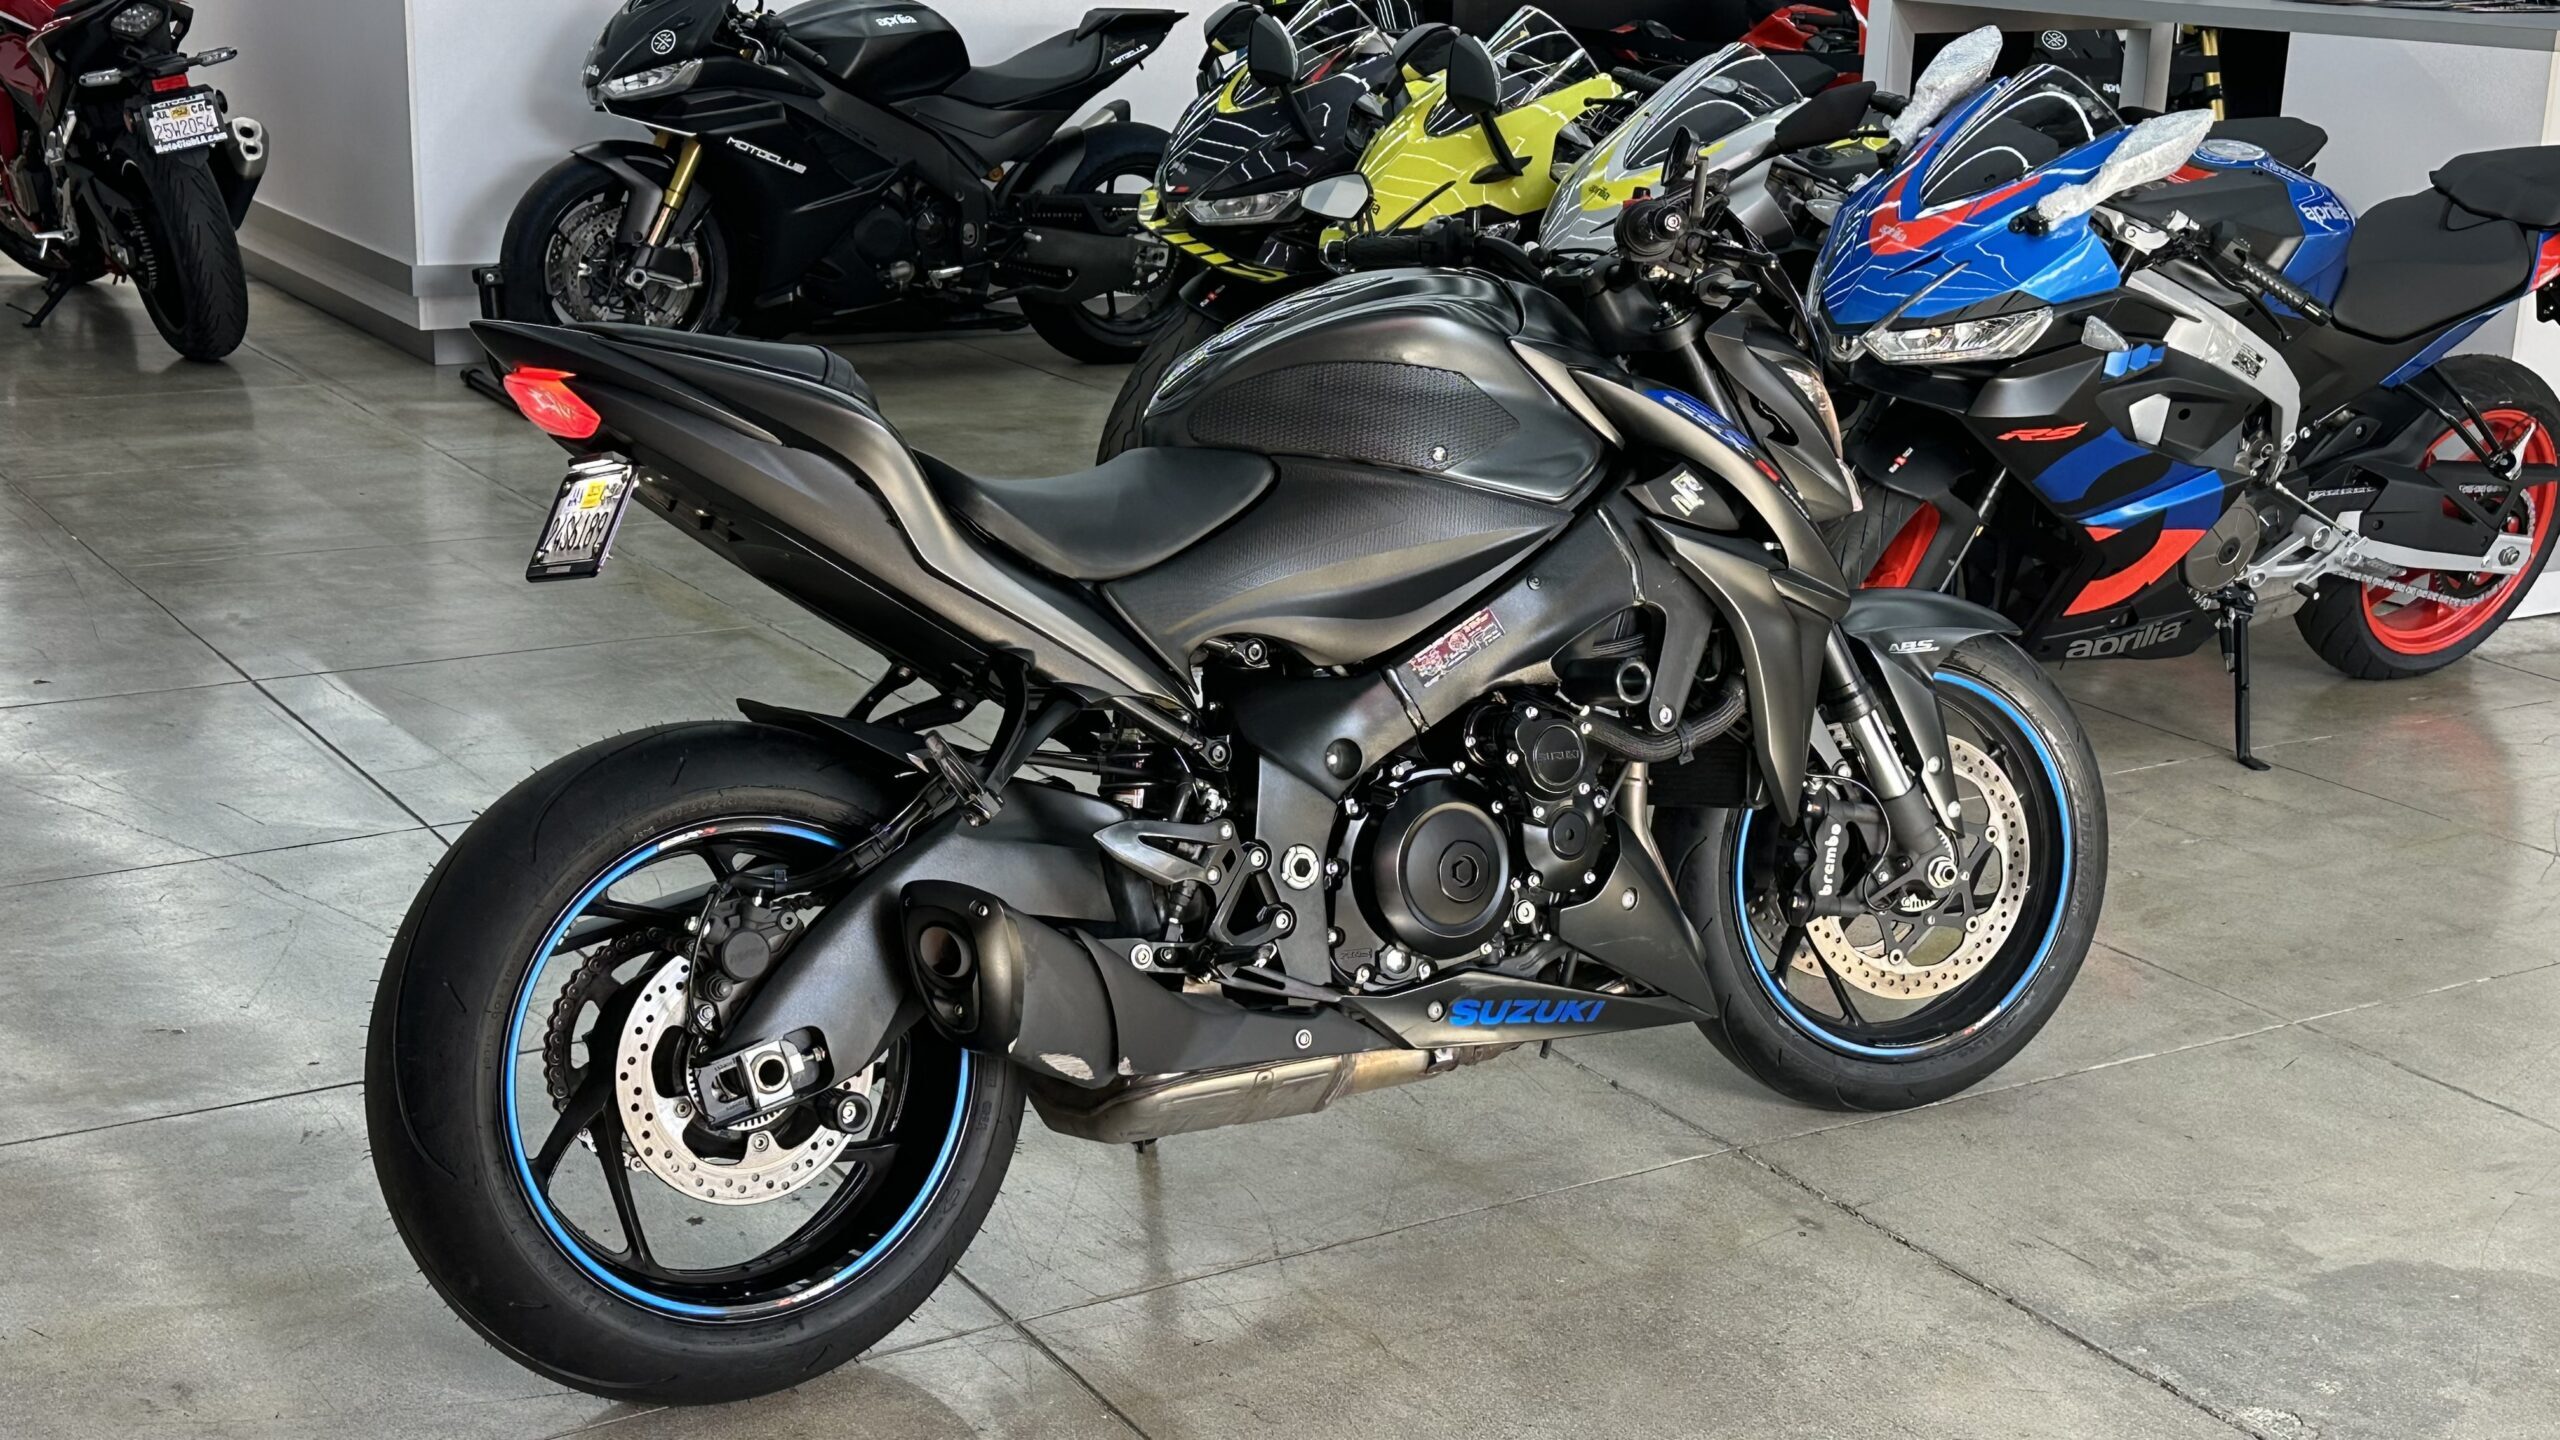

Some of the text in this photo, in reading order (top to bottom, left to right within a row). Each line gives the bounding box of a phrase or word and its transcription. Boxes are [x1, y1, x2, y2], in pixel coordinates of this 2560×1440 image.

[875, 13, 918, 28] aprilia
[726, 136, 807, 174] MOTOCLUB
[2302, 201, 2351, 221] aprilia
[1996, 421, 2088, 441] RS
[1887, 639, 1937, 652] ABS
[2065, 621, 2182, 658] aprilia
[1818, 823, 1842, 896] brembo
[1450, 999, 1606, 1027] SUZUKI
